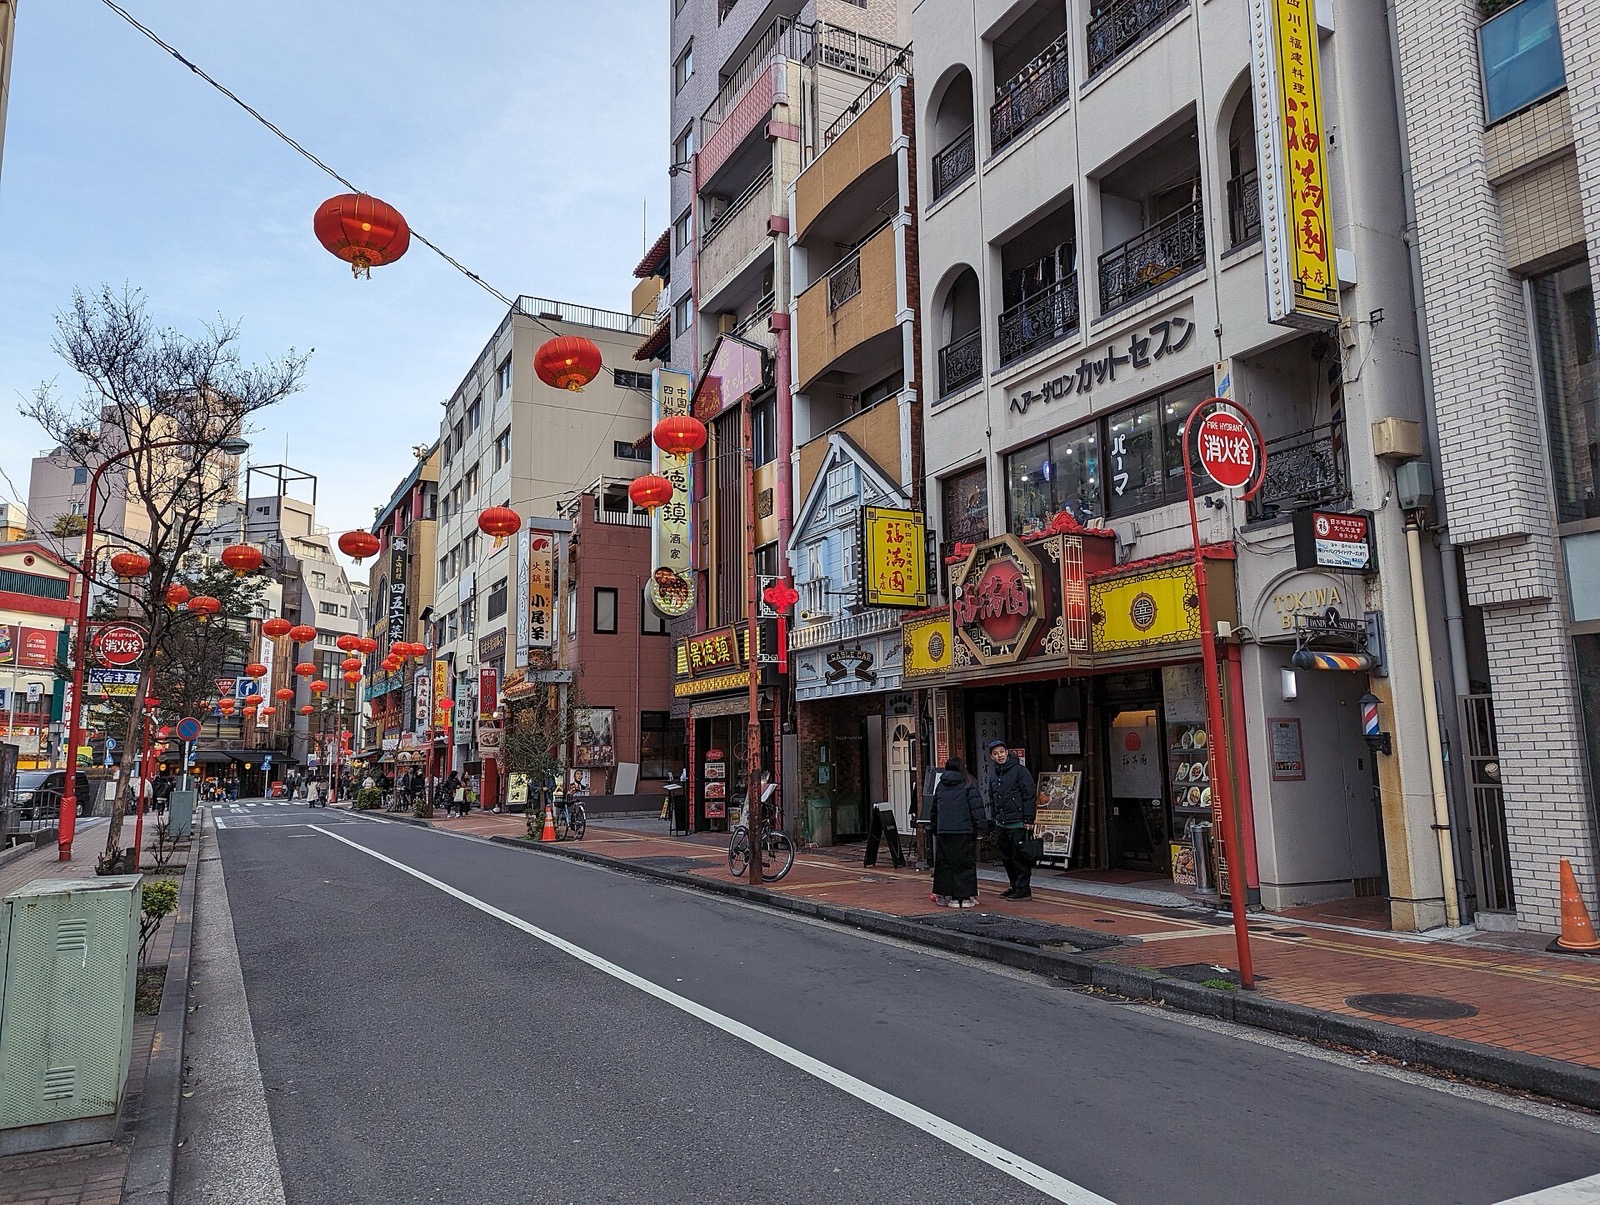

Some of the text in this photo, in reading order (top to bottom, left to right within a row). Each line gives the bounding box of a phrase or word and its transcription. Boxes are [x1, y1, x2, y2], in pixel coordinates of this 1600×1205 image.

[1300, 268, 1325, 286] 本店
[1206, 421, 1243, 433] FIRE HYDRANT
[1203, 433, 1251, 466] 消火栓
[1111, 433, 1129, 496] パーマ
[669, 533, 681, 559] 酒家
[531, 561, 542, 584] 火鍋
[879, 571, 887, 590] 本店
[1273, 586, 1343, 614] TOKIWA
[531, 593, 545, 641] 小尾羊
[1309, 618, 1356, 630] DANDY SALON
[105, 639, 140, 654] 消火栓
[830, 650, 872, 661] CABLE CAR
[92, 671, 140, 684] 広告主募
